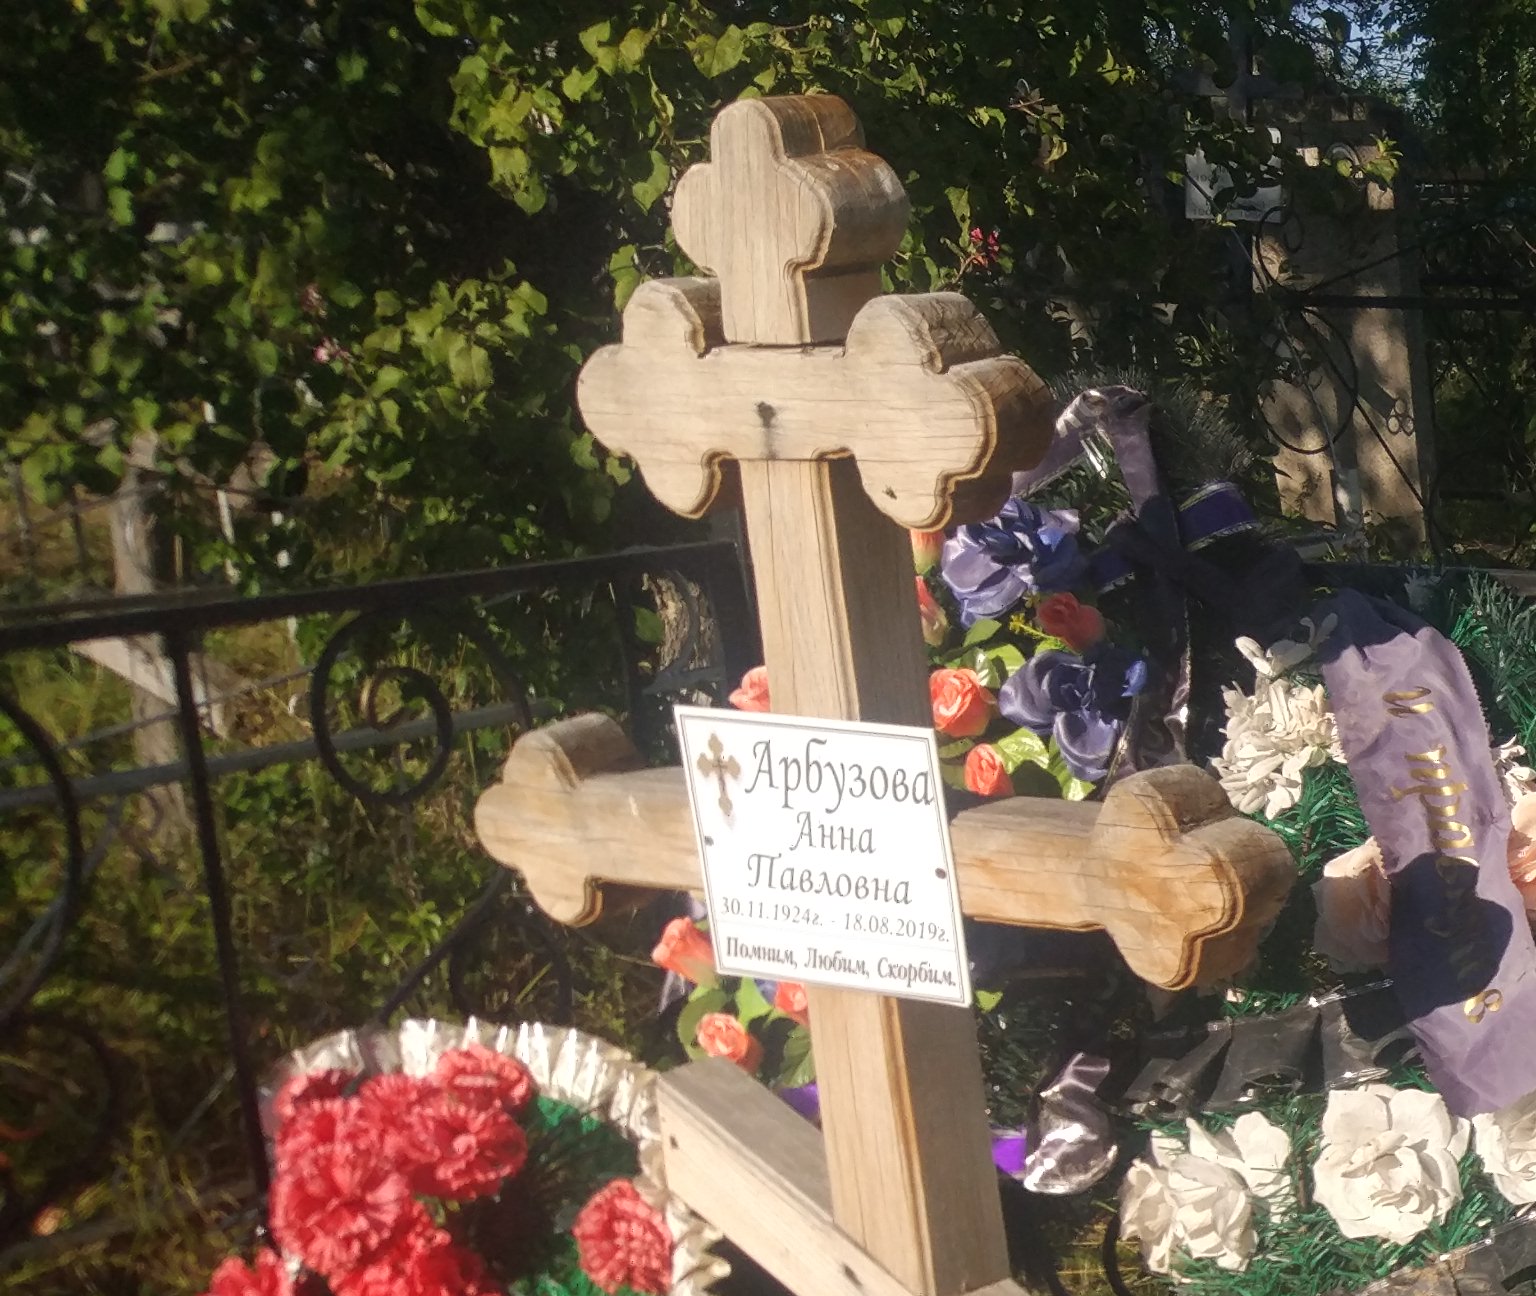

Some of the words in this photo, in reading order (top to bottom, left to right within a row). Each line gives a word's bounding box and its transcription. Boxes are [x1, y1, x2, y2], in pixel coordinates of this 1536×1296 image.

[744, 737, 935, 814] Арбузова
[789, 811, 877, 854] Анна
[747, 852, 913, 905] Павловна
[721, 896, 823, 928] 30.11.1924г.
[845, 912, 950, 943] 18.08.2019г.
[726, 936, 798, 969] Помним,
[804, 947, 870, 979] Любим,
[877, 957, 957, 988] Скорбим.
